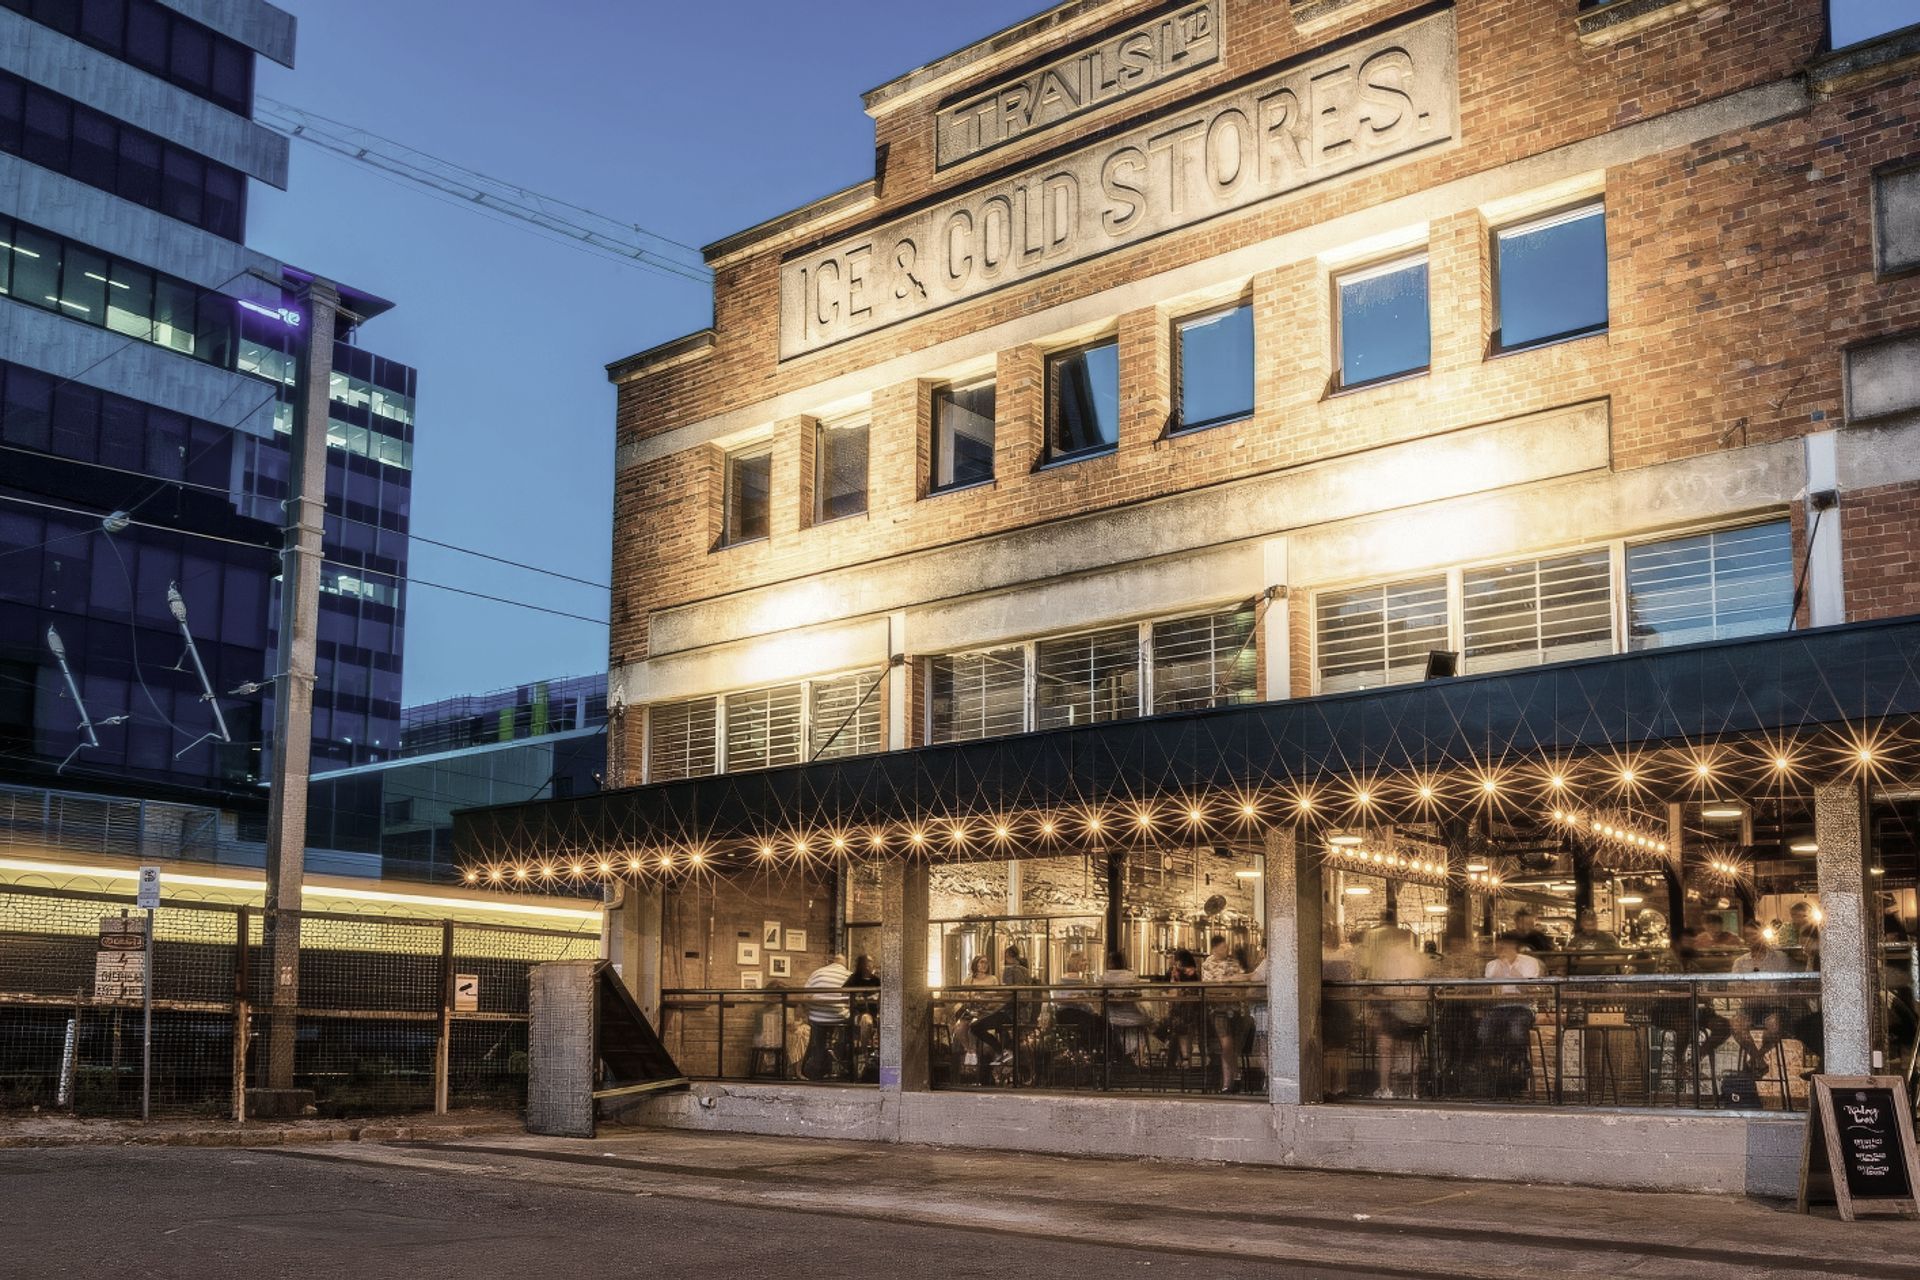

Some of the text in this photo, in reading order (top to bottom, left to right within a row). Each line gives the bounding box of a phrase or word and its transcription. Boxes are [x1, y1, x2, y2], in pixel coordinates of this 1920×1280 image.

[799, 46, 1433, 341] ICE & COLD STORES.
[952, 31, 1152, 153] TRAILS
